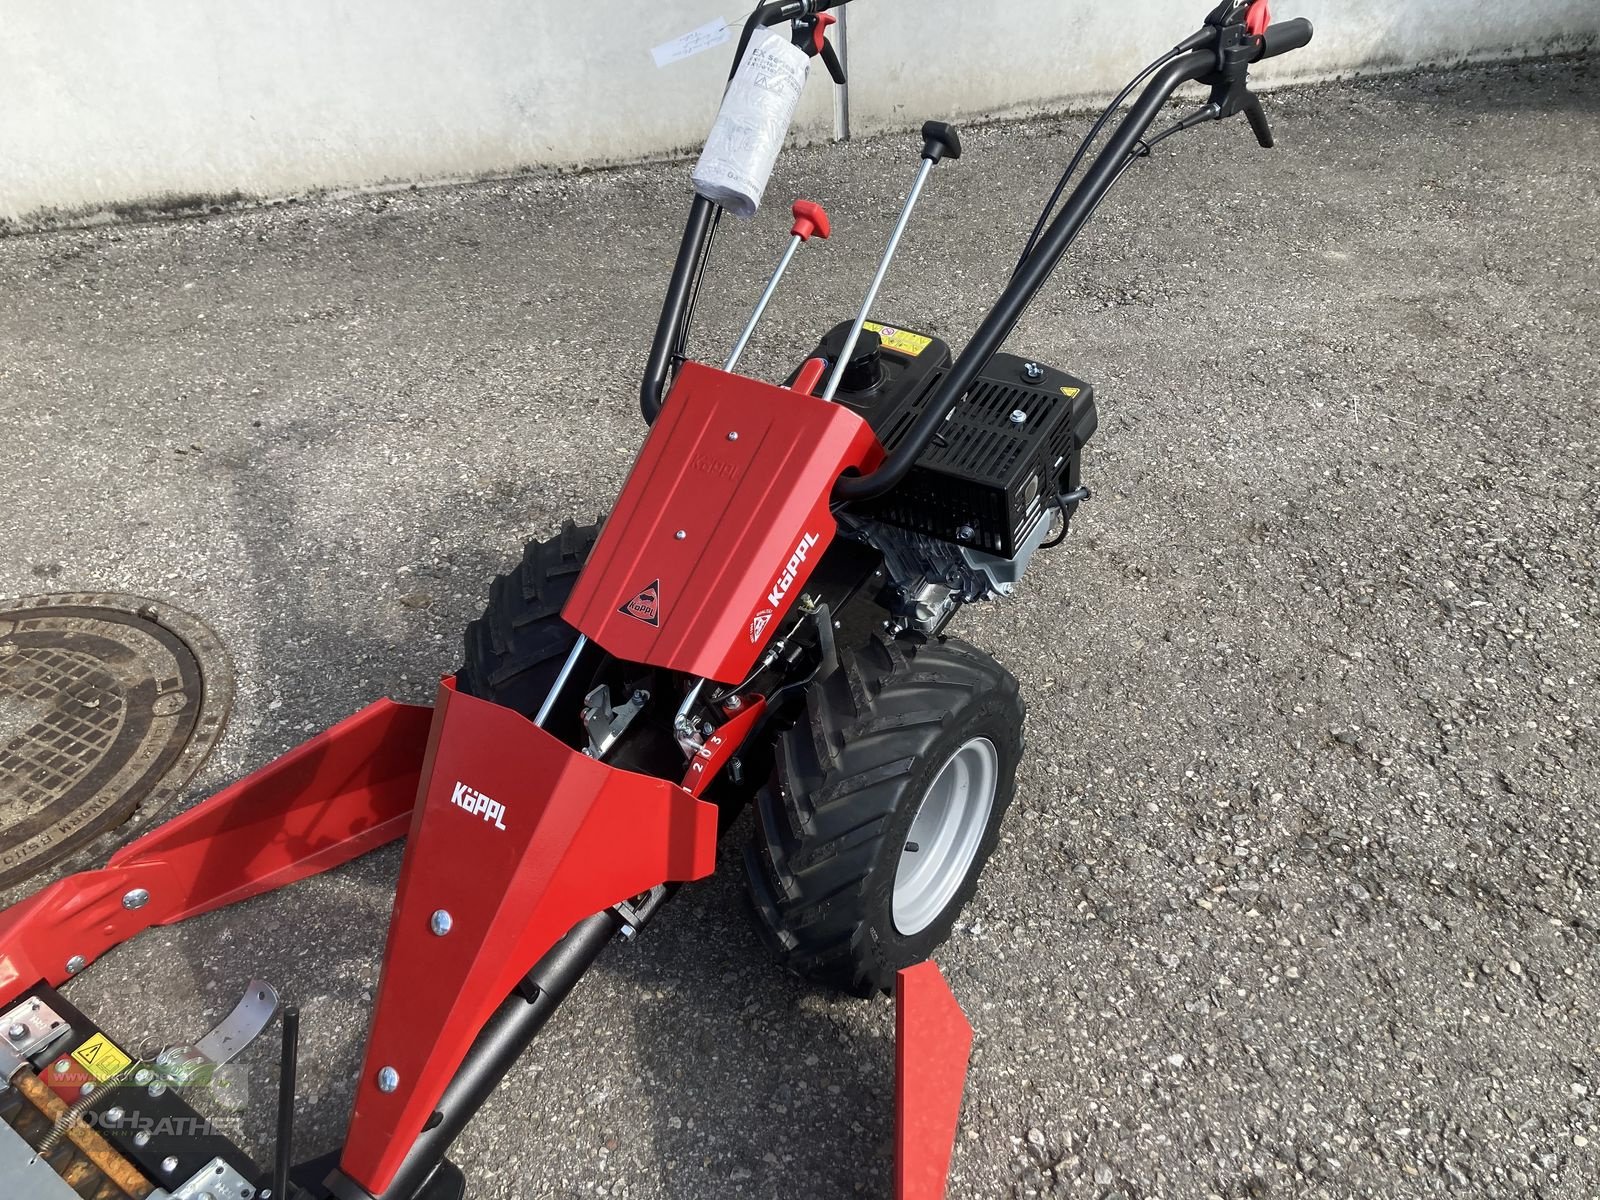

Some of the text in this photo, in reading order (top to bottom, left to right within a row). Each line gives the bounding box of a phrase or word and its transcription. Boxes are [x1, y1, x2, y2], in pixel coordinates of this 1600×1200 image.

[692, 762, 704, 772] 2
[701, 748, 712, 758] 0
[711, 736, 722, 745] 3
